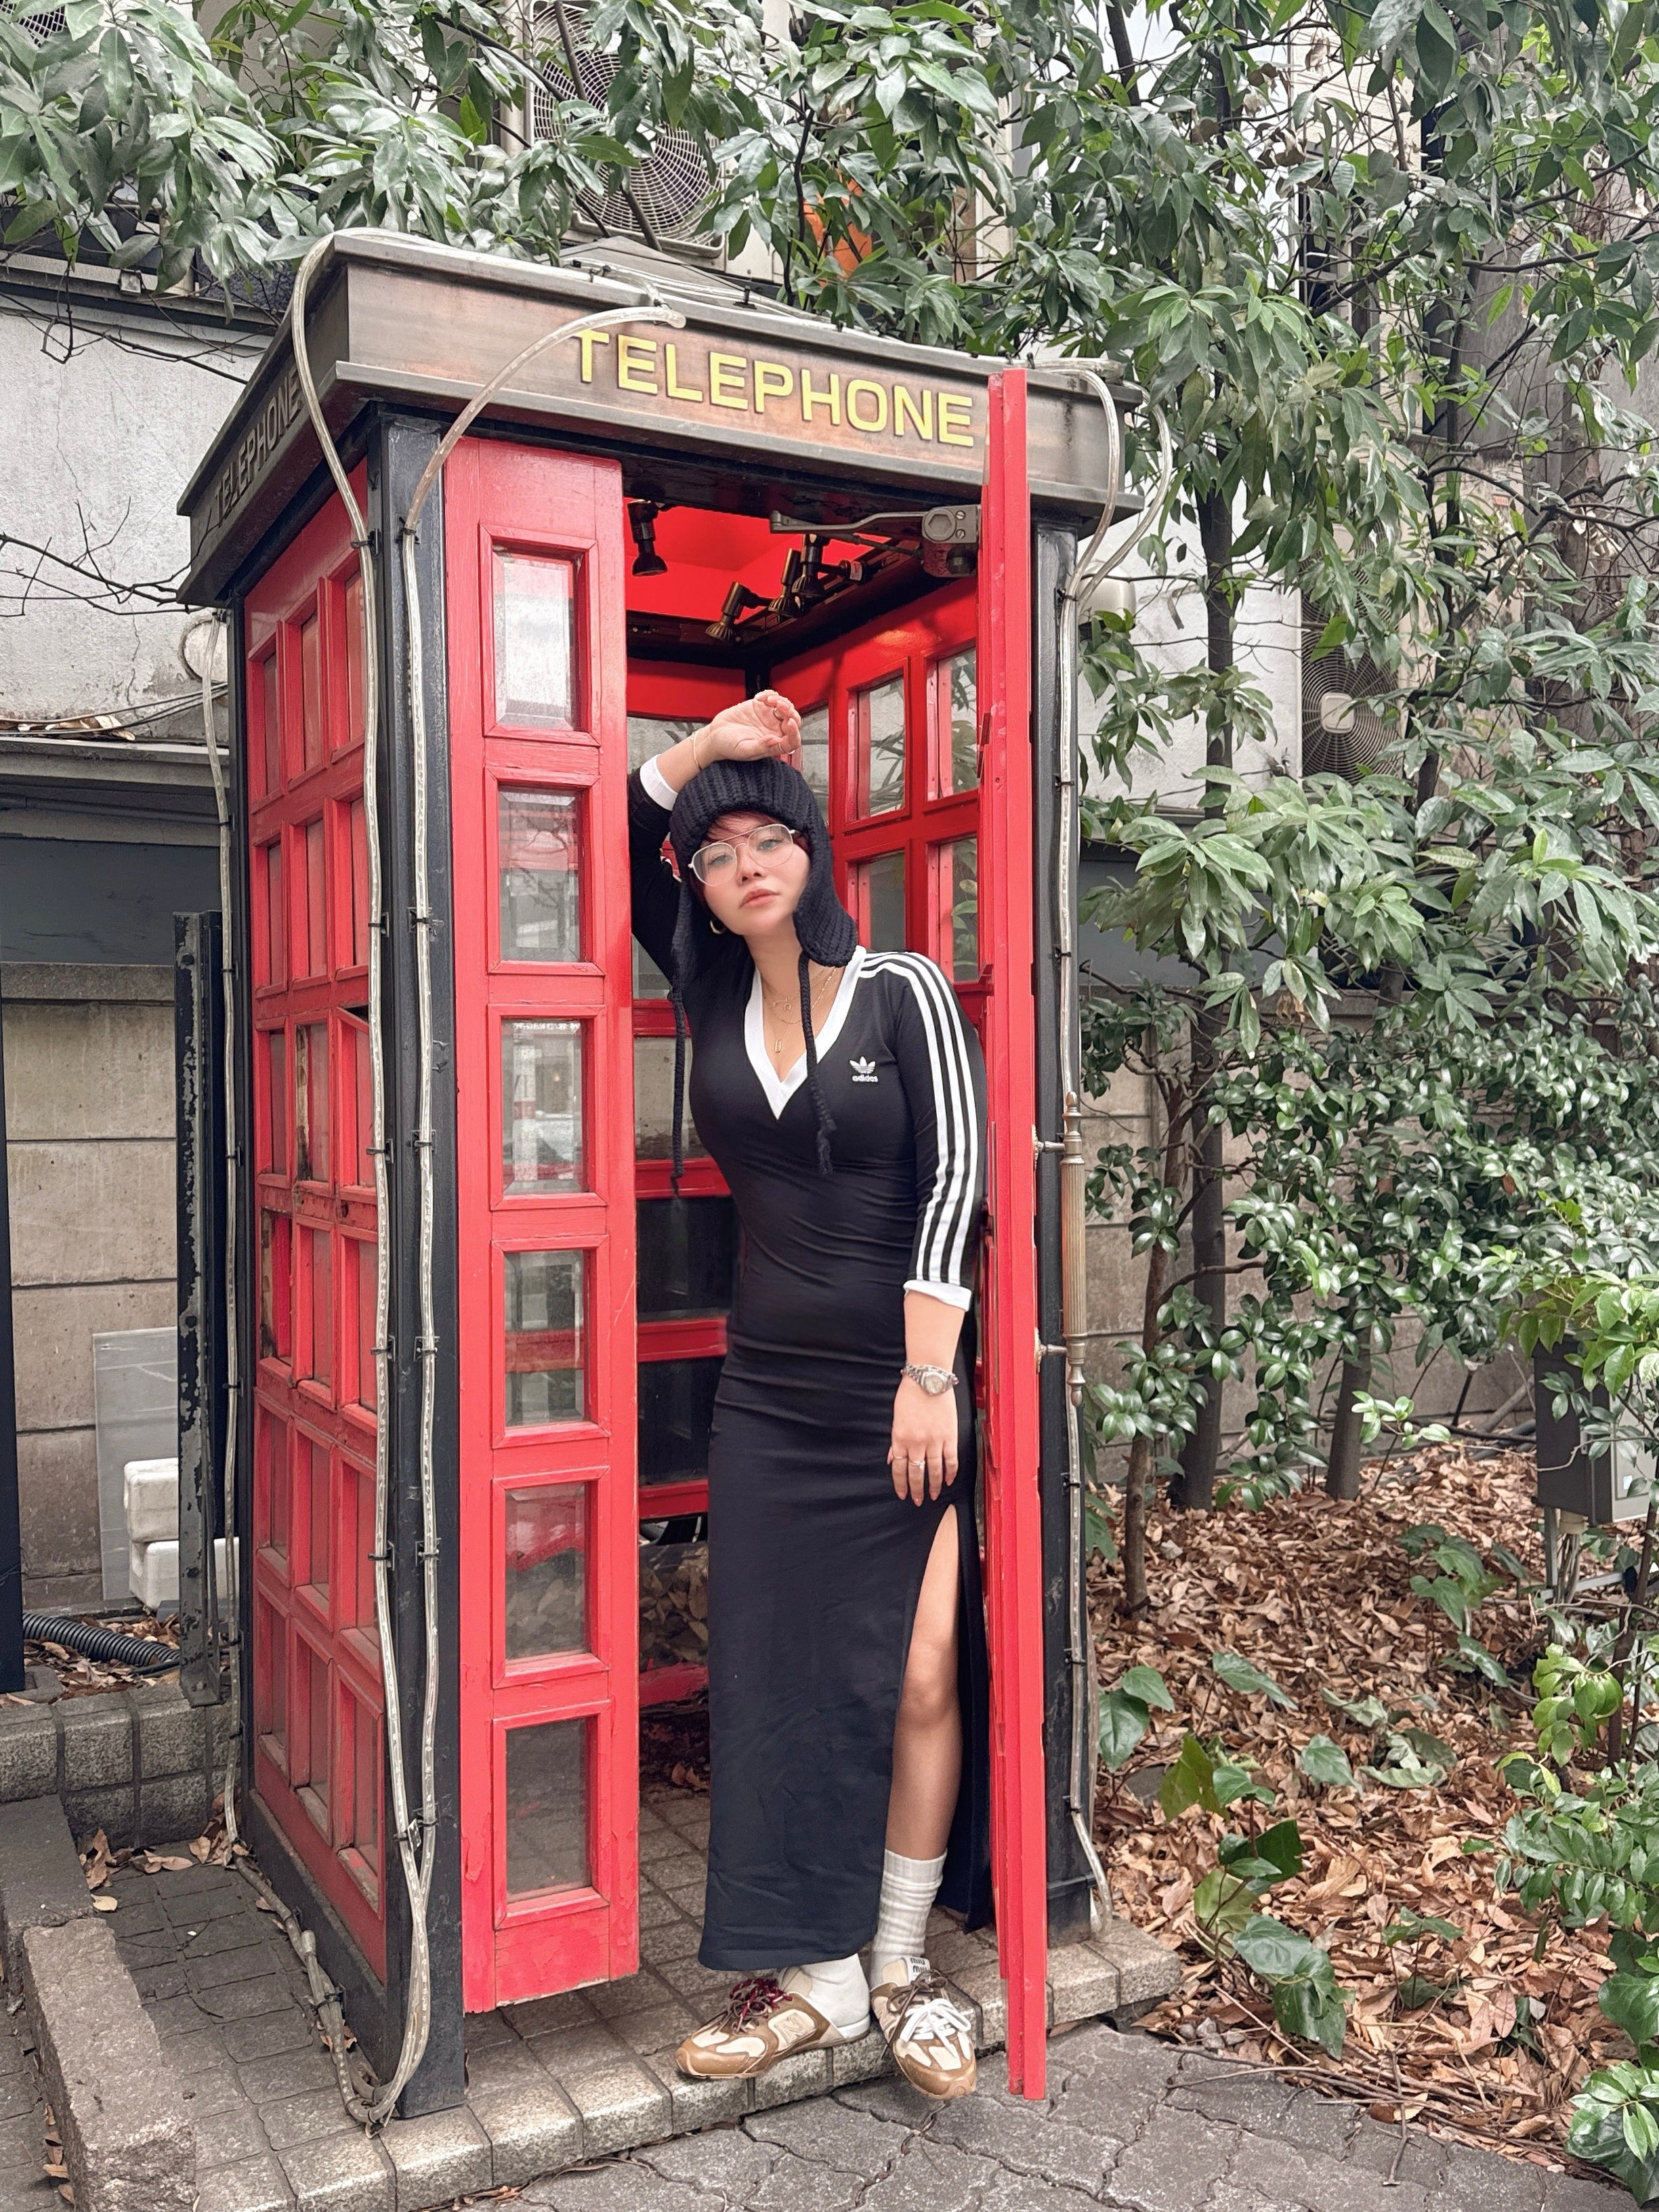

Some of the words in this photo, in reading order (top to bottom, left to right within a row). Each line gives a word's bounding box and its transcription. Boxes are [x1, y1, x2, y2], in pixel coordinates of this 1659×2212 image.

[215, 364, 302, 528] TELEPHONE
[570, 329, 974, 446] TELEPHONE
[852, 1074, 879, 1083] adidas
